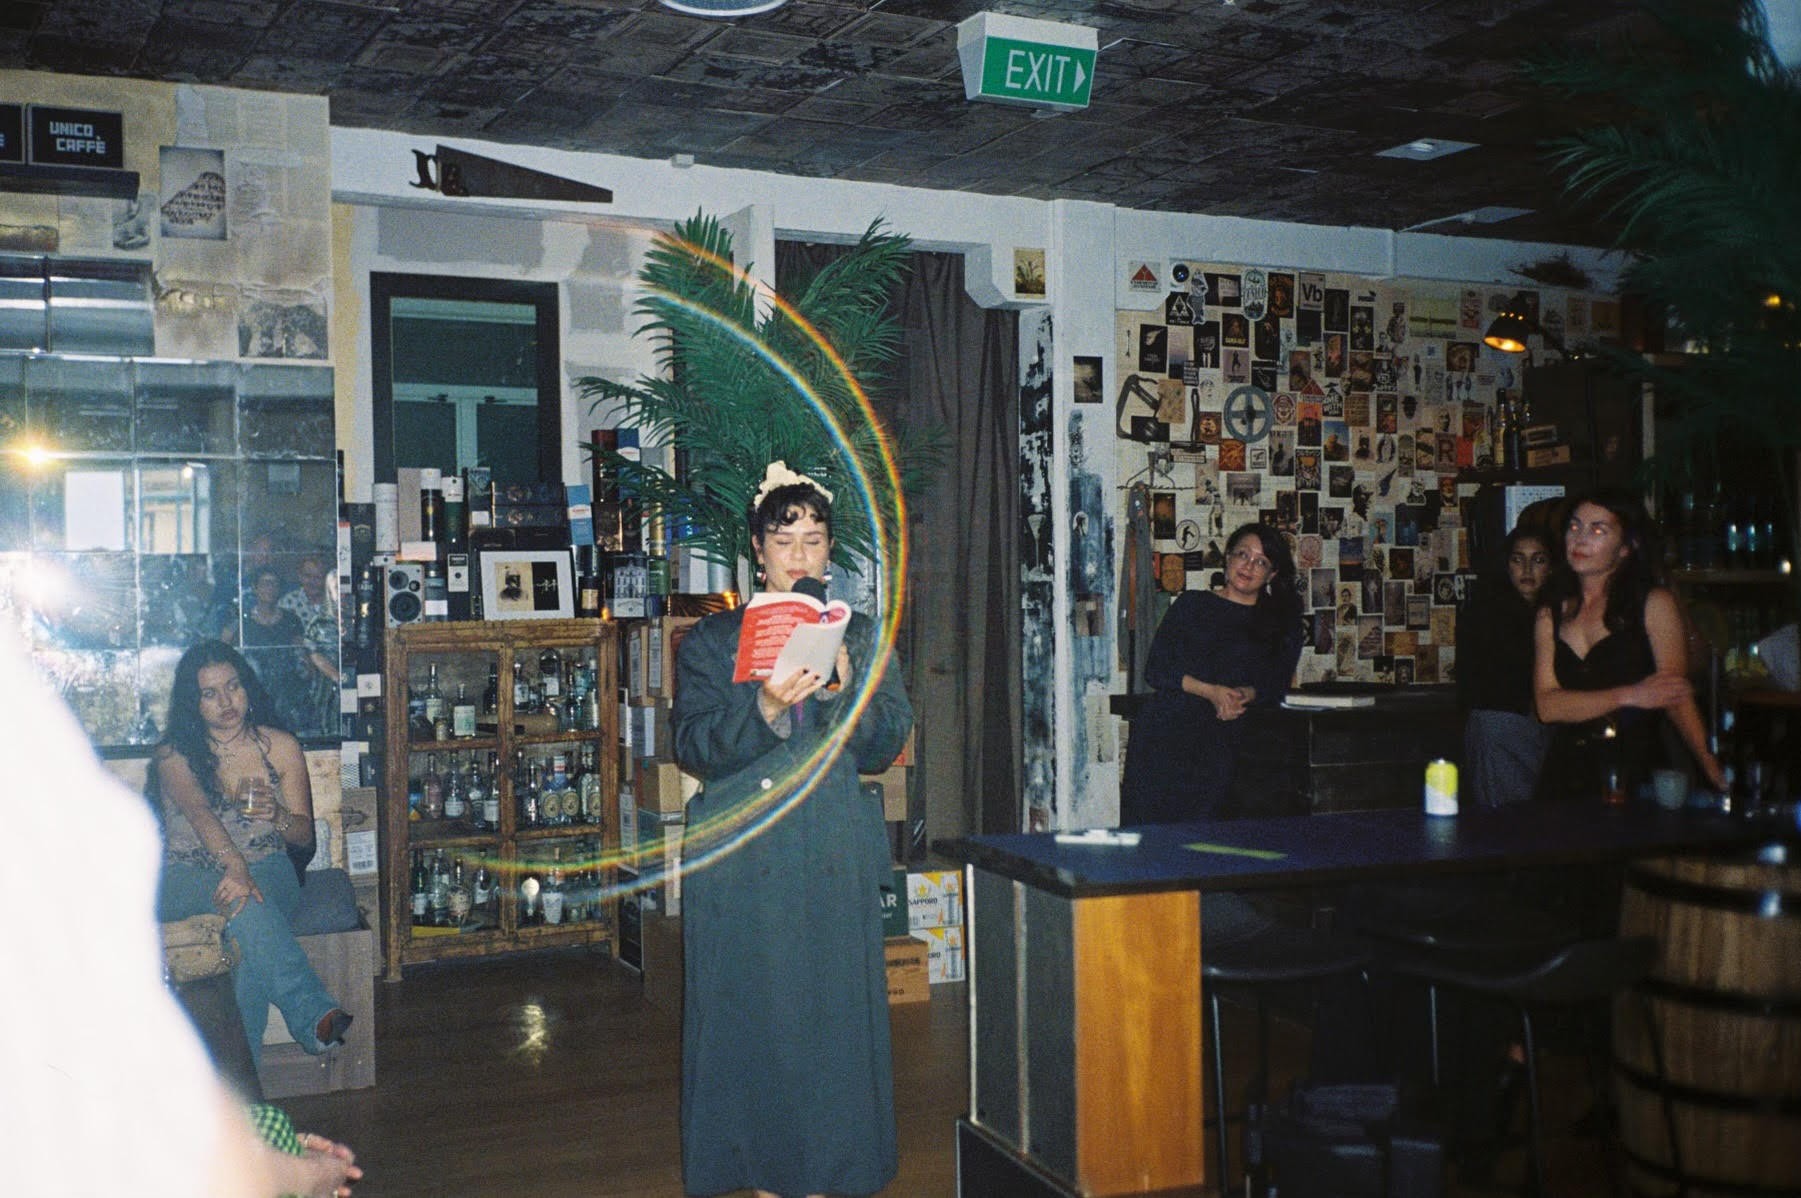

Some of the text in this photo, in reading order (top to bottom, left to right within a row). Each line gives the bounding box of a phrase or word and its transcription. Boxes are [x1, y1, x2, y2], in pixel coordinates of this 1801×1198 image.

[1005, 49, 1071, 94] EXIT
[49, 121, 94, 137] UNICO
[1302, 283, 1323, 303] Vb
[908, 897, 938, 905] SAPPORO
